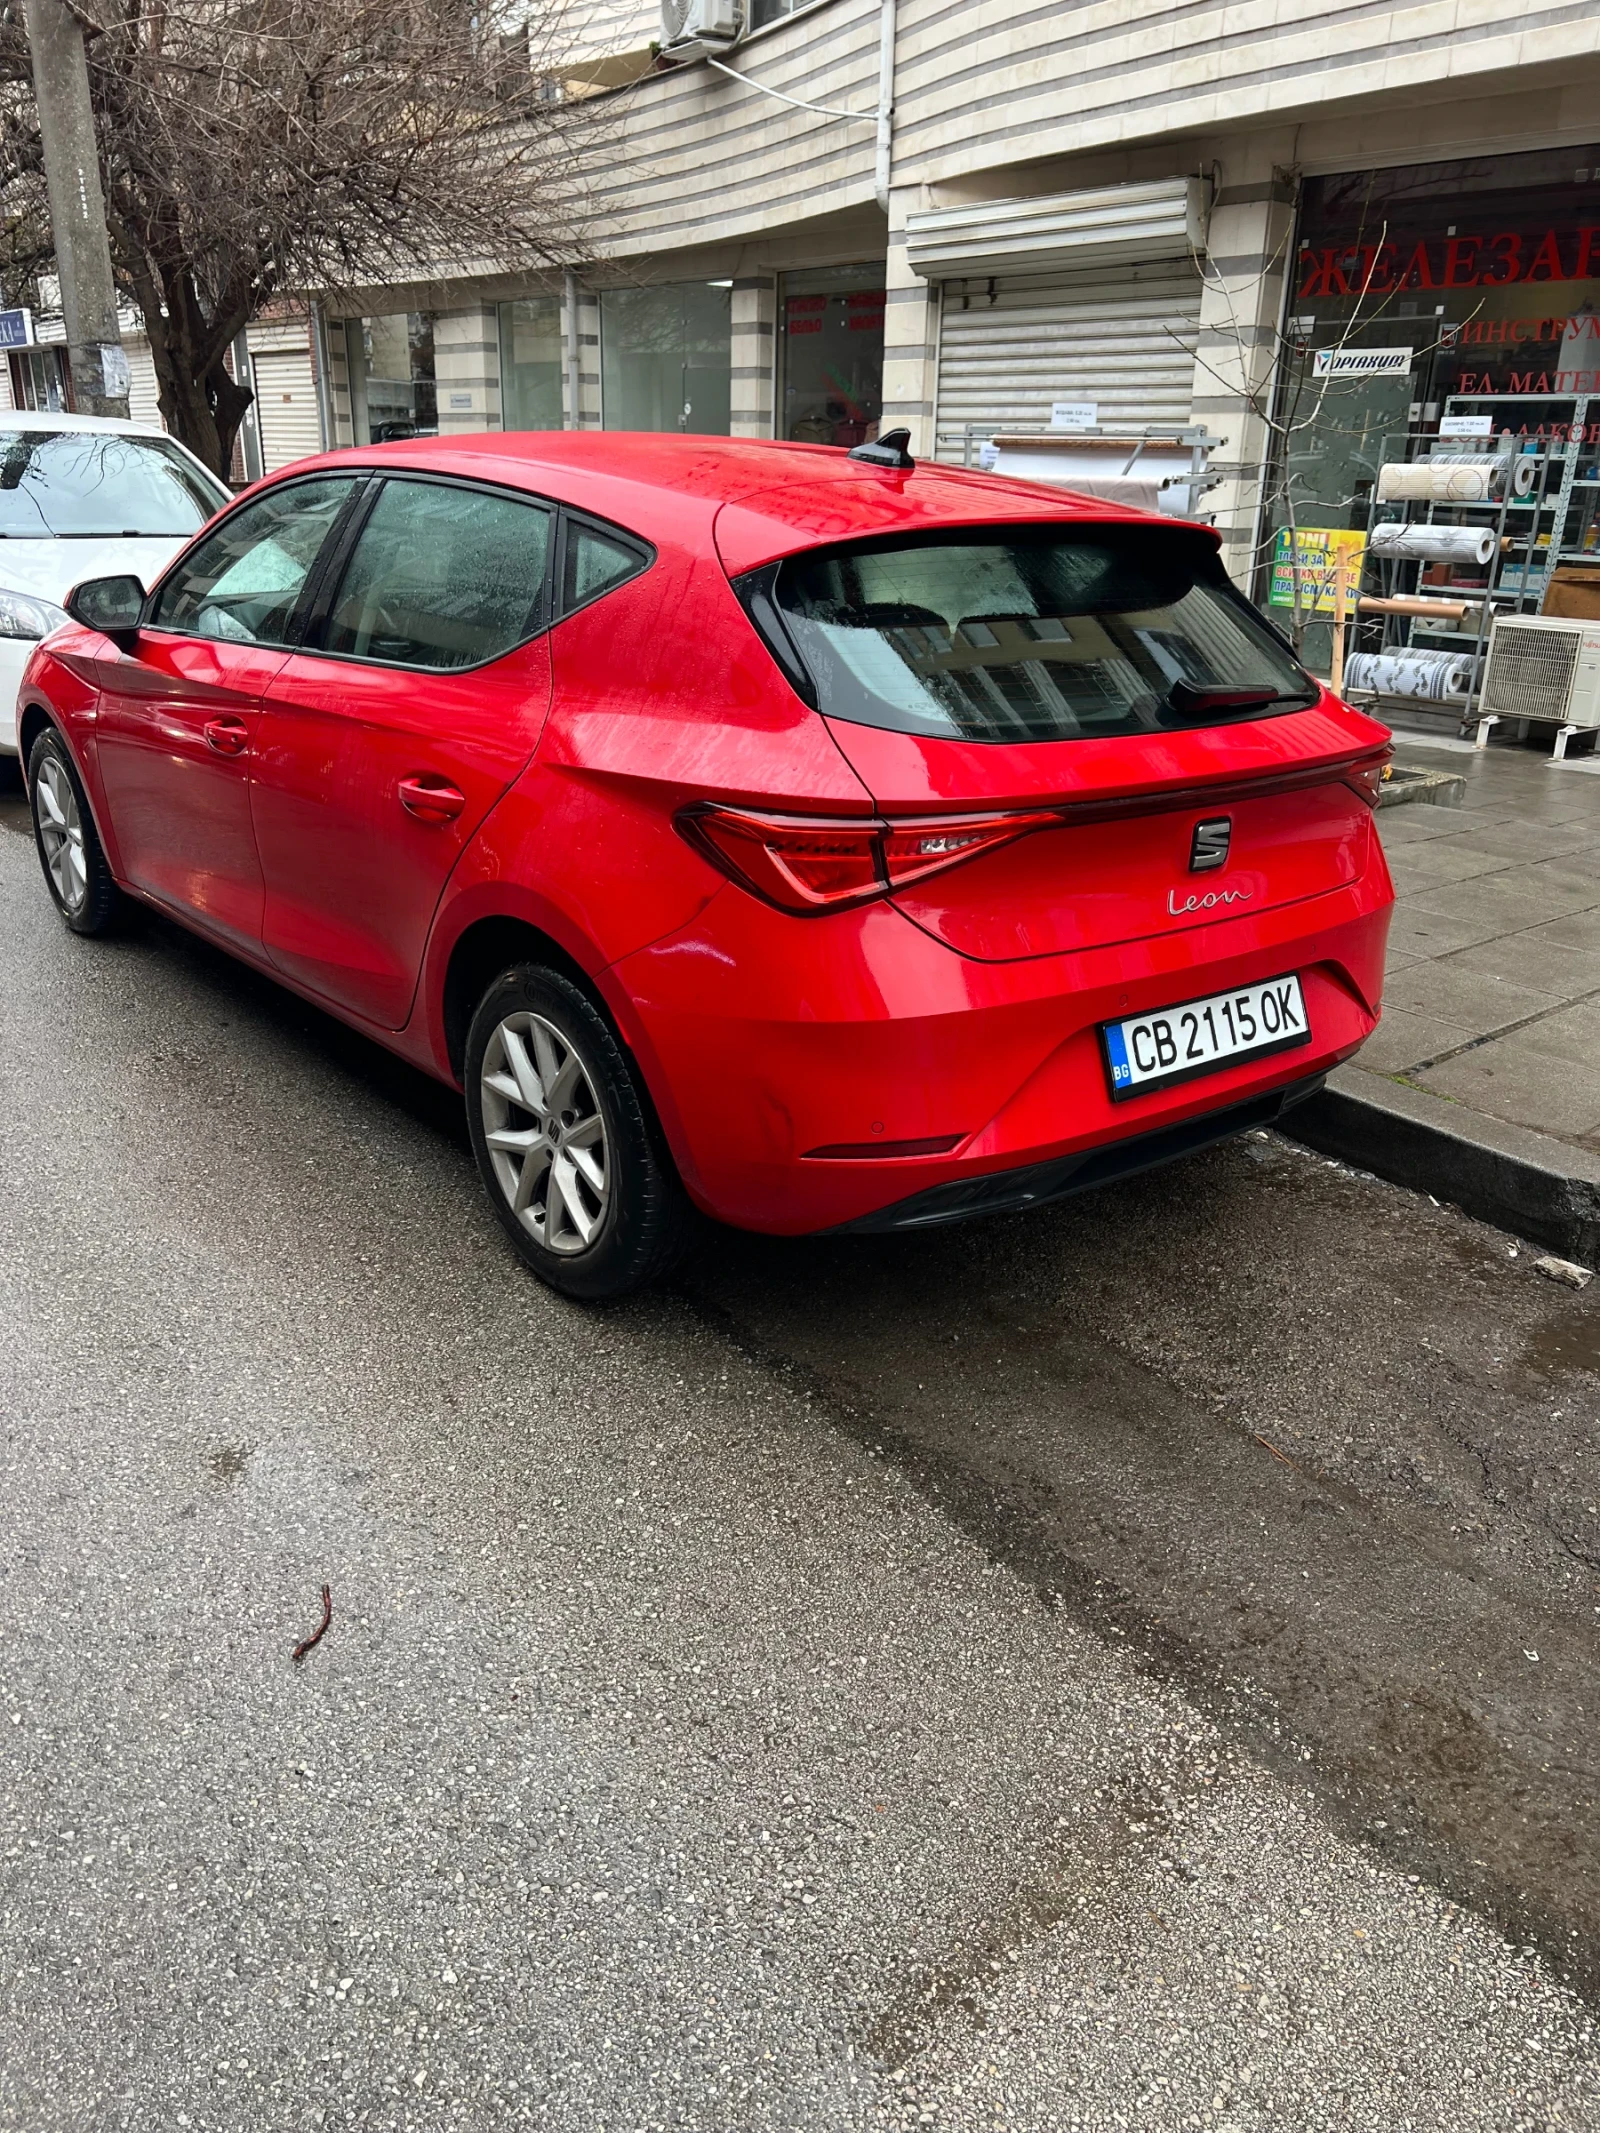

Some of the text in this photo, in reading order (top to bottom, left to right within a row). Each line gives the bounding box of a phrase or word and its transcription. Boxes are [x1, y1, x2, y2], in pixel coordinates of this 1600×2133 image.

[1458, 372, 1499, 394] ЕЛ.
[1167, 888, 1252, 915] Leon
[1131, 984, 1300, 1073] CB 2115 OK
[1113, 1064, 1130, 1081] BG
